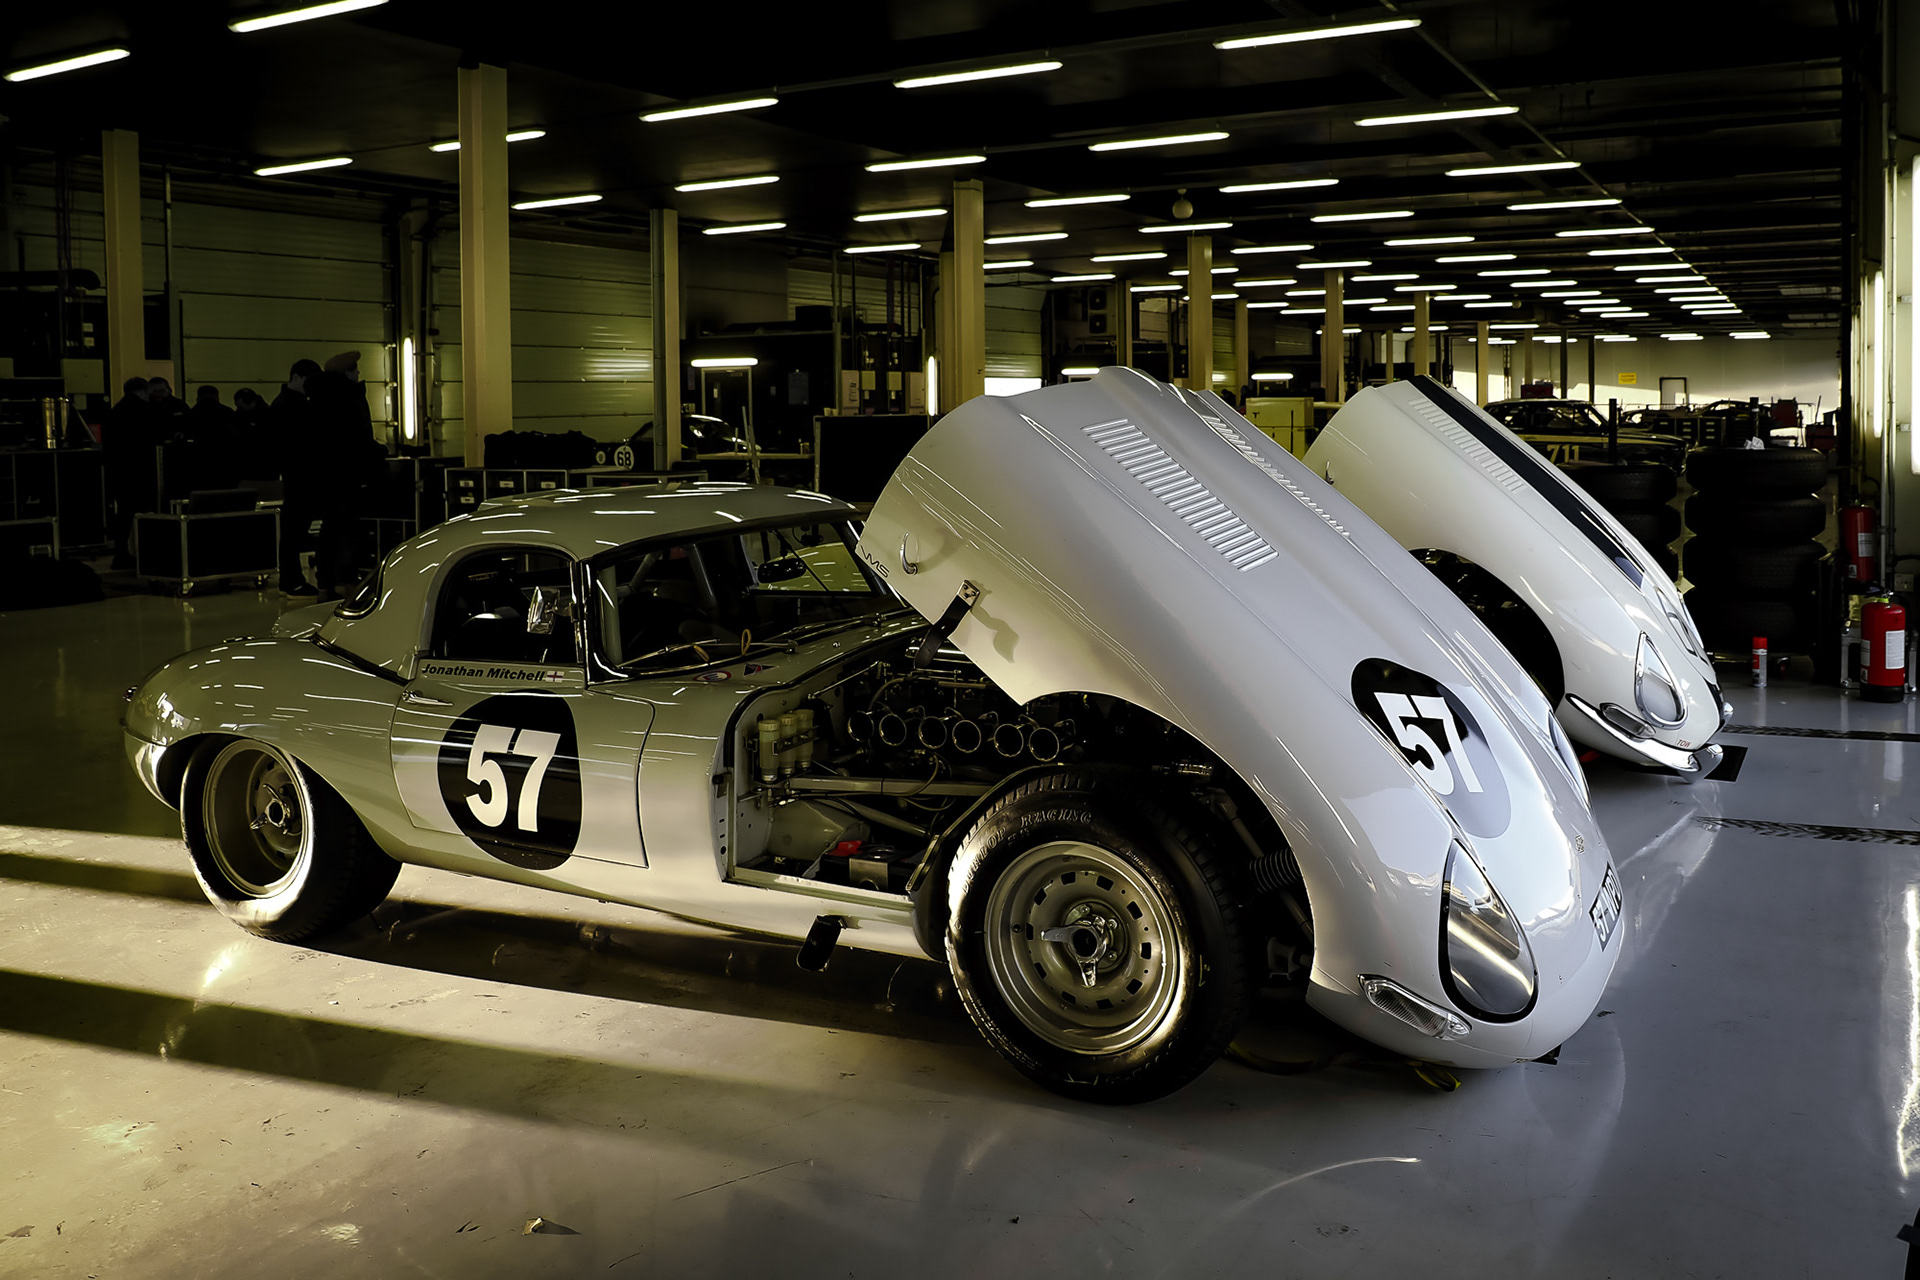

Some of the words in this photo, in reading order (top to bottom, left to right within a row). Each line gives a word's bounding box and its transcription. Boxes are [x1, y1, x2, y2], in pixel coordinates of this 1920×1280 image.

[617, 451, 632, 467] 68
[1547, 444, 1580, 464] 711
[421, 663, 484, 678] Jonathan
[486, 667, 546, 682] Mitchell
[1373, 691, 1484, 796] 57
[1676, 739, 1691, 748] TOW
[465, 723, 561, 833] 57
[1020, 808, 1092, 828] RACING
[1592, 899, 1610, 943] 57
